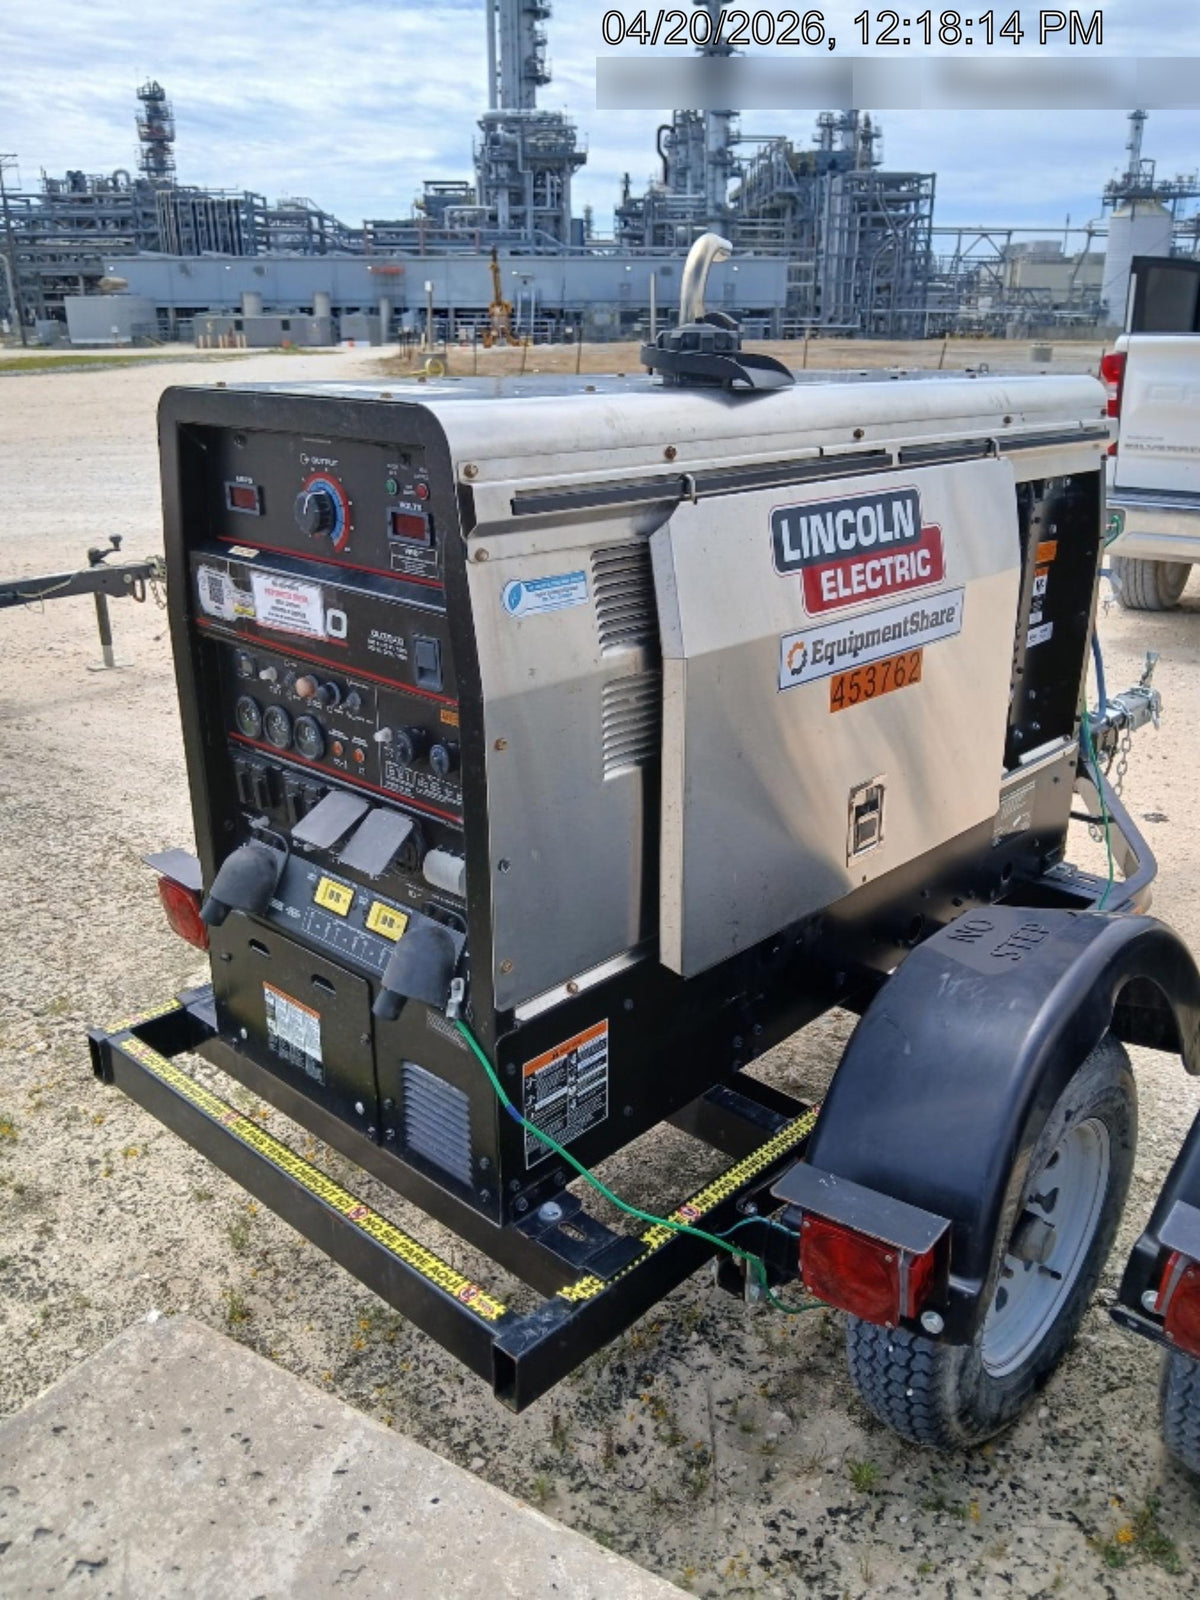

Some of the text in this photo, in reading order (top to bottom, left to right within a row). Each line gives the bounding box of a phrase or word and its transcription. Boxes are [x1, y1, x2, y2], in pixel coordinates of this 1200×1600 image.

[780, 499, 915, 562] LINCOLN
[820, 549, 931, 601] ELECTRIC
[811, 606, 956, 666] EquipmentShare
[831, 651, 921, 707] 453762
[947, 920, 994, 943] NO
[990, 923, 1049, 960] STEP
[265, 1142, 297, 1165] TENEZ
[294, 1167, 337, 1196] DEBOUT
[363, 1217, 383, 1232] NO
[381, 1230, 400, 1243] SE
[398, 1241, 431, 1268] PARE
